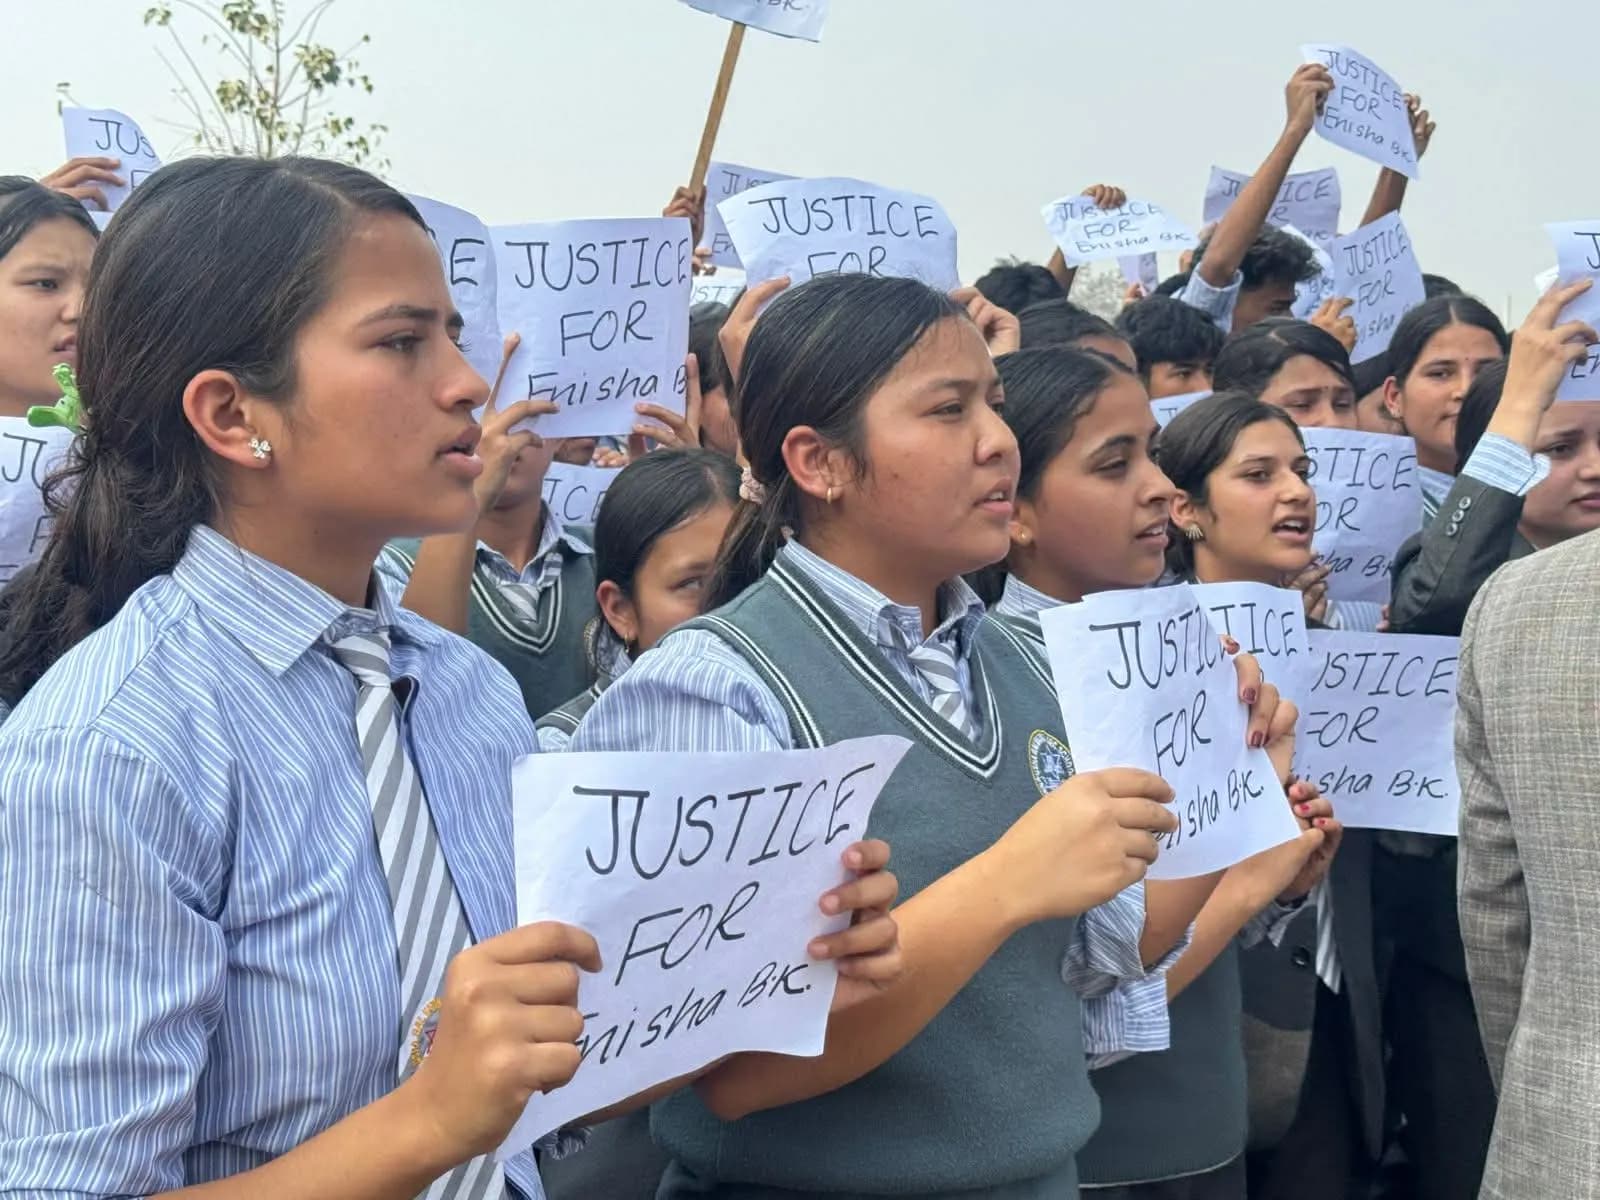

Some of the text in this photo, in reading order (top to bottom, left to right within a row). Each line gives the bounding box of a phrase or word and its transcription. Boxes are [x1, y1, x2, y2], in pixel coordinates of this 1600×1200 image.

[1318, 48, 1402, 111] JUSTICE
[1341, 85, 1383, 120] FOR
[1324, 106, 1385, 145] Enisha
[748, 195, 939, 238] JUSTICE
[1084, 219, 1140, 240] FOR
[504, 237, 690, 292] JUSTICE
[807, 245, 888, 277] FOR
[1343, 223, 1408, 277] JUSTICE
[1358, 269, 1396, 313] FOR
[559, 299, 654, 357] FOR
[1305, 447, 1418, 491] STICE
[1313, 496, 1361, 533] OR
[1209, 602, 1298, 657] TICE
[1309, 650, 1459, 697] STICE
[1153, 690, 1212, 777] FOR
[572, 763, 876, 880] JUSTICE
[1151, 784, 1221, 851] isha
[613, 881, 760, 987] FOR
